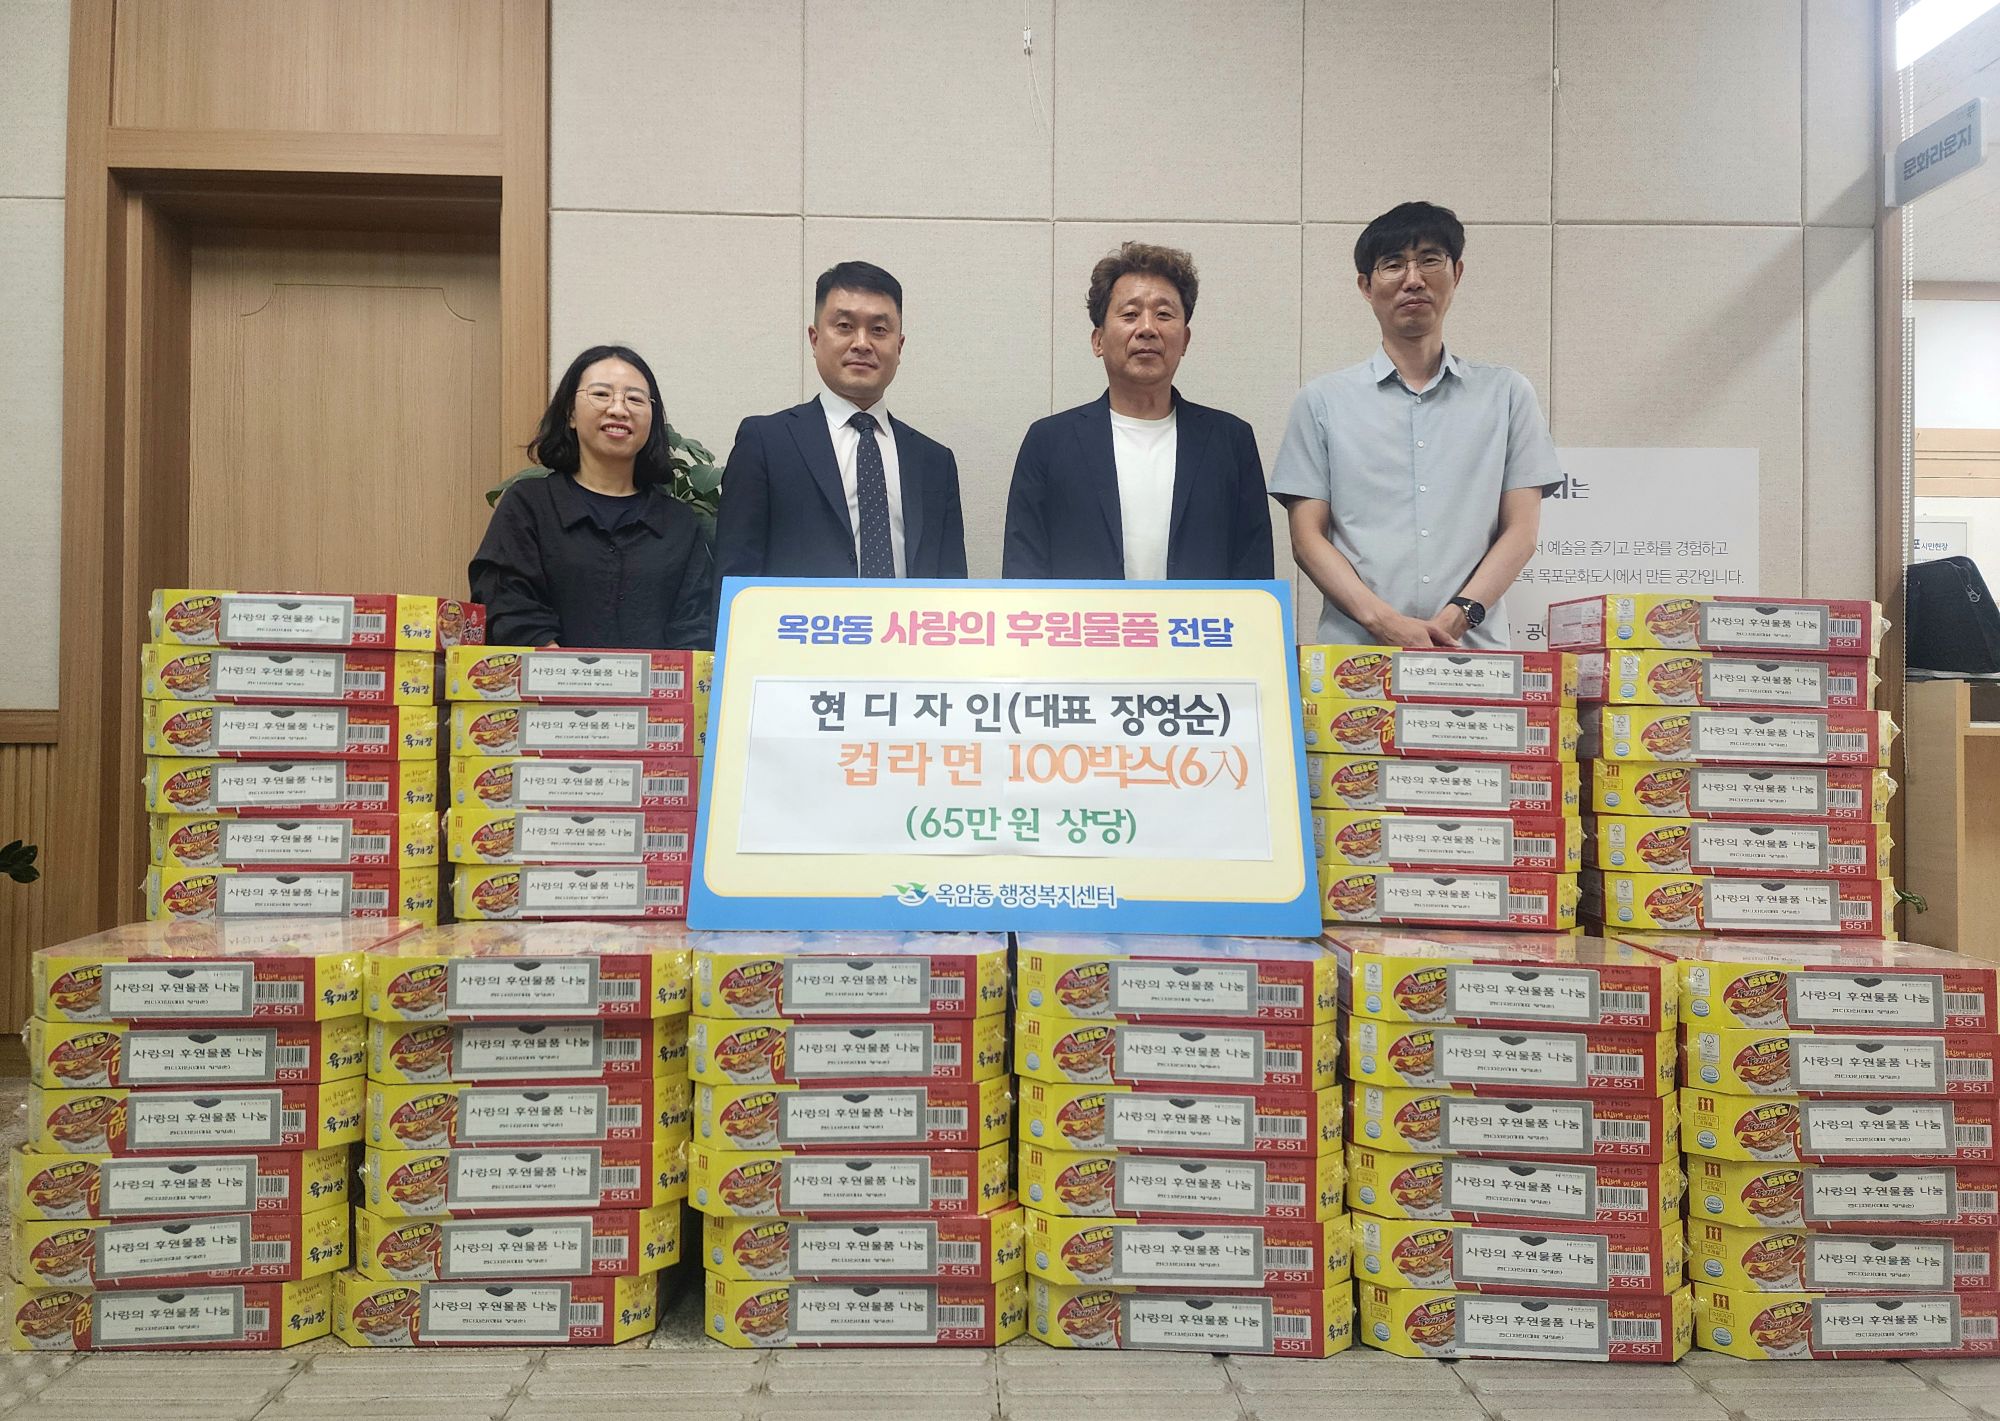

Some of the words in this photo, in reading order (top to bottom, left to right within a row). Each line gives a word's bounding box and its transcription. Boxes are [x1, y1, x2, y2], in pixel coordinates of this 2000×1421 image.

[1548, 540, 1587, 556] 예술을
[1590, 540, 1630, 556] 즐기고
[1633, 540, 1672, 556] 문화를
[1675, 540, 1729, 557] 경험하고
[1537, 568, 1642, 585] 목포문화도시에서
[1645, 569, 1673, 585] 만든
[1675, 568, 1745, 585] 공간입니다.
[400, 625, 432, 640] 육개장
[777, 614, 874, 645] 옥암동
[880, 610, 996, 647] 사랑의
[1006, 610, 1159, 648] 후원물품
[1168, 617, 1234, 648] 전달
[530, 666, 567, 677] 사랑의
[569, 667, 614, 678] 후원물품
[616, 668, 640, 678] 나눔
[1401, 666, 1438, 677] 사랑의
[1439, 667, 1486, 678] 후원물품
[1488, 669, 1512, 679] 나눔
[400, 681, 430, 696] 육개장
[1110, 692, 1231, 737] 장영순)
[528, 720, 564, 730] 사랑의
[567, 720, 611, 731] 후원물품
[613, 720, 636, 731] 나눔
[1404, 718, 1441, 729] 사랑의
[1443, 720, 1489, 731] 후원물품
[1491, 722, 1516, 732] 나눔
[1701, 725, 1739, 736] 사랑의
[1742, 727, 1789, 738] 후원물품
[1791, 728, 1816, 739] 나눔
[220, 776, 258, 787] 사랑의
[261, 774, 307, 785] 후원물품
[310, 774, 334, 784] 나눔
[1701, 782, 1738, 792] 사랑의
[1741, 783, 1788, 794] 후원물품
[1790, 784, 1815, 795] 나눔
[1056, 807, 1138, 845] 상당)
[228, 833, 266, 844] 사랑의
[268, 833, 313, 844] 후원물품
[316, 834, 341, 844] 나눔
[1700, 836, 1739, 847] 사랑의
[1741, 838, 1790, 849] 후원물품
[1792, 839, 1818, 851] 나눔
[404, 844, 434, 858] 육개장
[934, 882, 995, 906] 옥암동
[998, 883, 1117, 907] 행정복지센터
[1386, 887, 1423, 898] 사랑의
[1425, 888, 1471, 899] 후원물품
[1473, 890, 1498, 901] 나눔
[1713, 893, 1751, 904] 사랑의
[1754, 894, 1801, 905] 후원물품
[1804, 895, 1829, 905] 나눔
[1747, 972, 1779, 988] BIG
[113, 982, 154, 994] 사랑의
[158, 982, 210, 993] 후원물품
[213, 982, 241, 993] 나눔
[655, 985, 688, 1004] 육개장
[321, 989, 360, 1005] 육개장
[1799, 989, 1842, 1002] 사랑의
[1845, 991, 1900, 1003] 후원물품
[1903, 992, 1931, 1005] 나눔
[274, 1005, 299, 1016] 551
[936, 1000, 960, 1011] 551
[1955, 1017, 1981, 1028] 551
[73, 1033, 106, 1050] BIG
[1755, 1038, 1789, 1056] BIG
[131, 1048, 175, 1060] 사랑의
[178, 1047, 233, 1059] 후원물품
[236, 1046, 264, 1058] 나눔
[1801, 1055, 1844, 1067] 사랑의
[1847, 1056, 1901, 1068] 후원물품
[1904, 1057, 1933, 1069] 나눔
[1590, 1077, 1608, 1088] 72
[1613, 1078, 1639, 1089] 551
[1758, 1104, 1789, 1121] BIG
[1451, 1115, 1493, 1127] 사랑의
[1497, 1116, 1550, 1129] 후원물품
[1553, 1118, 1581, 1130] 나눔
[1811, 1119, 1854, 1131] 사랑의
[1858, 1118, 1911, 1131] 후원물품
[1914, 1118, 1942, 1131] 나눔
[1597, 1143, 1614, 1153] 72
[1619, 1144, 1645, 1154] 551
[1962, 1149, 1988, 1160] 551
[53, 1163, 86, 1180] BIG
[411, 1158, 444, 1174] BIG
[460, 1167, 502, 1179] 사랑의
[505, 1165, 557, 1178] 후원물품
[561, 1165, 589, 1177] 나눔
[111, 1179, 155, 1190] 사랑의
[159, 1177, 213, 1189] 후원물품
[216, 1176, 244, 1188] 나눔
[792, 1175, 833, 1186] 사랑의
[836, 1174, 887, 1187] 후원물품
[891, 1174, 917, 1186] 나눔
[1126, 1174, 1167, 1187] 사랑의
[1171, 1176, 1223, 1190] 후원물품
[1225, 1179, 1253, 1192] 나눔
[1454, 1175, 1496, 1189] 사랑의
[1499, 1179, 1552, 1193] 후원물품
[1556, 1183, 1584, 1196] 나눔
[1766, 1171, 1798, 1188] BIG
[307, 1178, 345, 1198] 육개장
[1815, 1185, 1858, 1197] 사랑의
[1860, 1185, 1916, 1197] 후원물품
[1918, 1185, 1947, 1197] 나눔
[401, 1225, 433, 1242] BIG
[1415, 1230, 1447, 1247] BIG
[307, 1242, 344, 1263] 육개장
[452, 1242, 494, 1254] 사랑의
[496, 1240, 549, 1253] 후원물품
[552, 1239, 580, 1252] 나눔
[643, 1240, 675, 1259] 육개장
[799, 1240, 841, 1252] 사랑의
[844, 1240, 895, 1252] 후원물품
[898, 1239, 925, 1251] 나눔
[1124, 1243, 1165, 1255] 사랑의
[1169, 1244, 1221, 1256] 후원물품
[1224, 1244, 1252, 1257] 나눔
[1464, 1246, 1507, 1259] 사랑의
[1510, 1249, 1564, 1263] 후원물품
[1567, 1252, 1596, 1265] 나눔
[431, 1300, 473, 1312] 사랑의
[475, 1300, 528, 1312] 후원물품
[531, 1300, 559, 1312] 나눔
[800, 1300, 841, 1312] 사랑의
[844, 1300, 896, 1313] 후원물품
[898, 1300, 926, 1313] 나눔
[288, 1310, 327, 1331] 육개장
[619, 1305, 652, 1325] 육개장
[1132, 1312, 1174, 1324] 사랑의
[1177, 1313, 1230, 1326] 후원물품
[1233, 1315, 1261, 1328] 나눔
[573, 1327, 598, 1338] 551
[1282, 1340, 1307, 1351] 551
[1609, 1343, 1628, 1354] 72
[1632, 1343, 1658, 1354] 551
